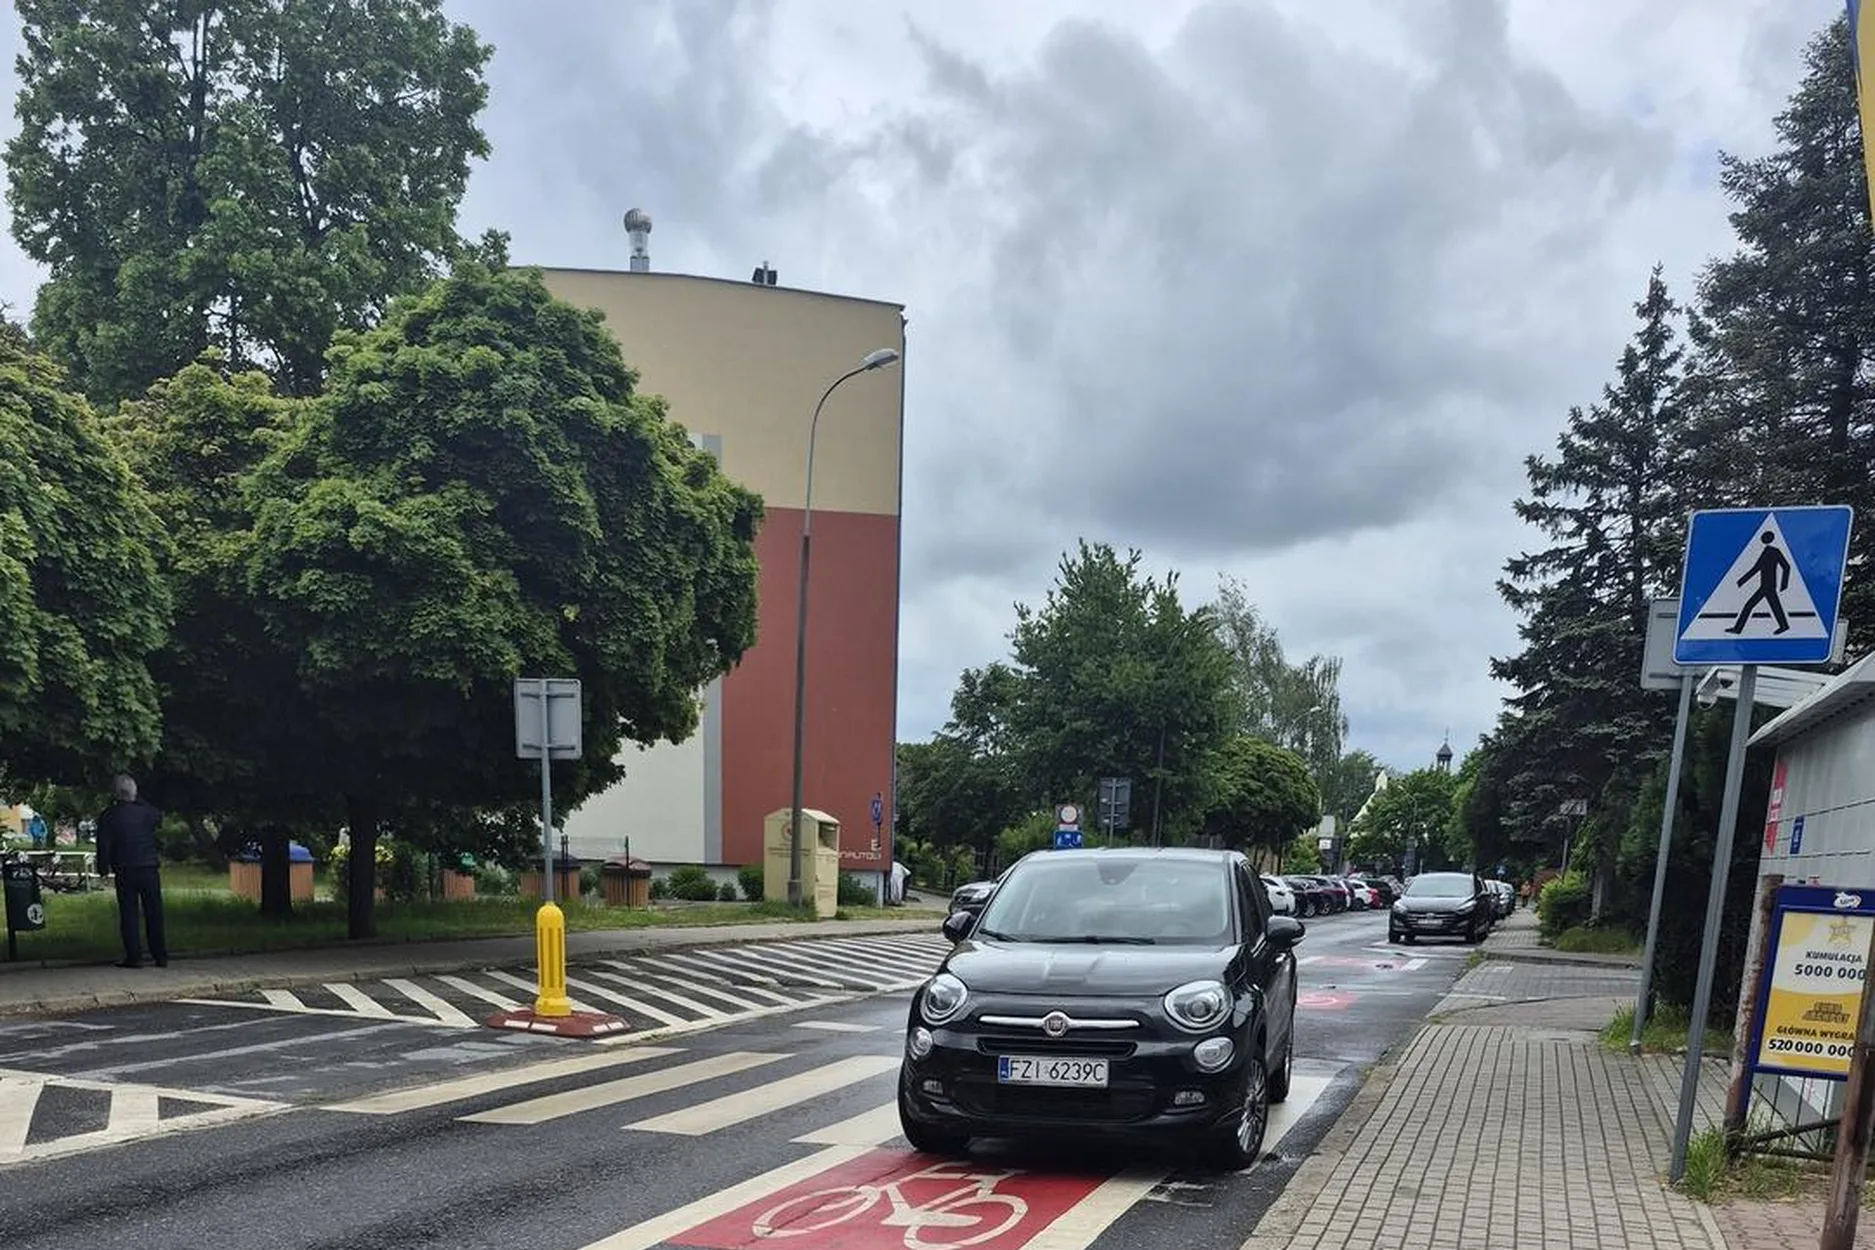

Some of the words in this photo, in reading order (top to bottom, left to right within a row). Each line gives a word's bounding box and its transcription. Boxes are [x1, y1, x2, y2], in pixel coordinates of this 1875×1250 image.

[1806, 950, 1862, 963] KUMULACJA
[1777, 1025, 1817, 1037] GŁÓWNA
[1820, 1030, 1855, 1040] WYGRA
[1010, 1060, 1040, 1079] FZI
[1049, 1062, 1105, 1082] 6239C
